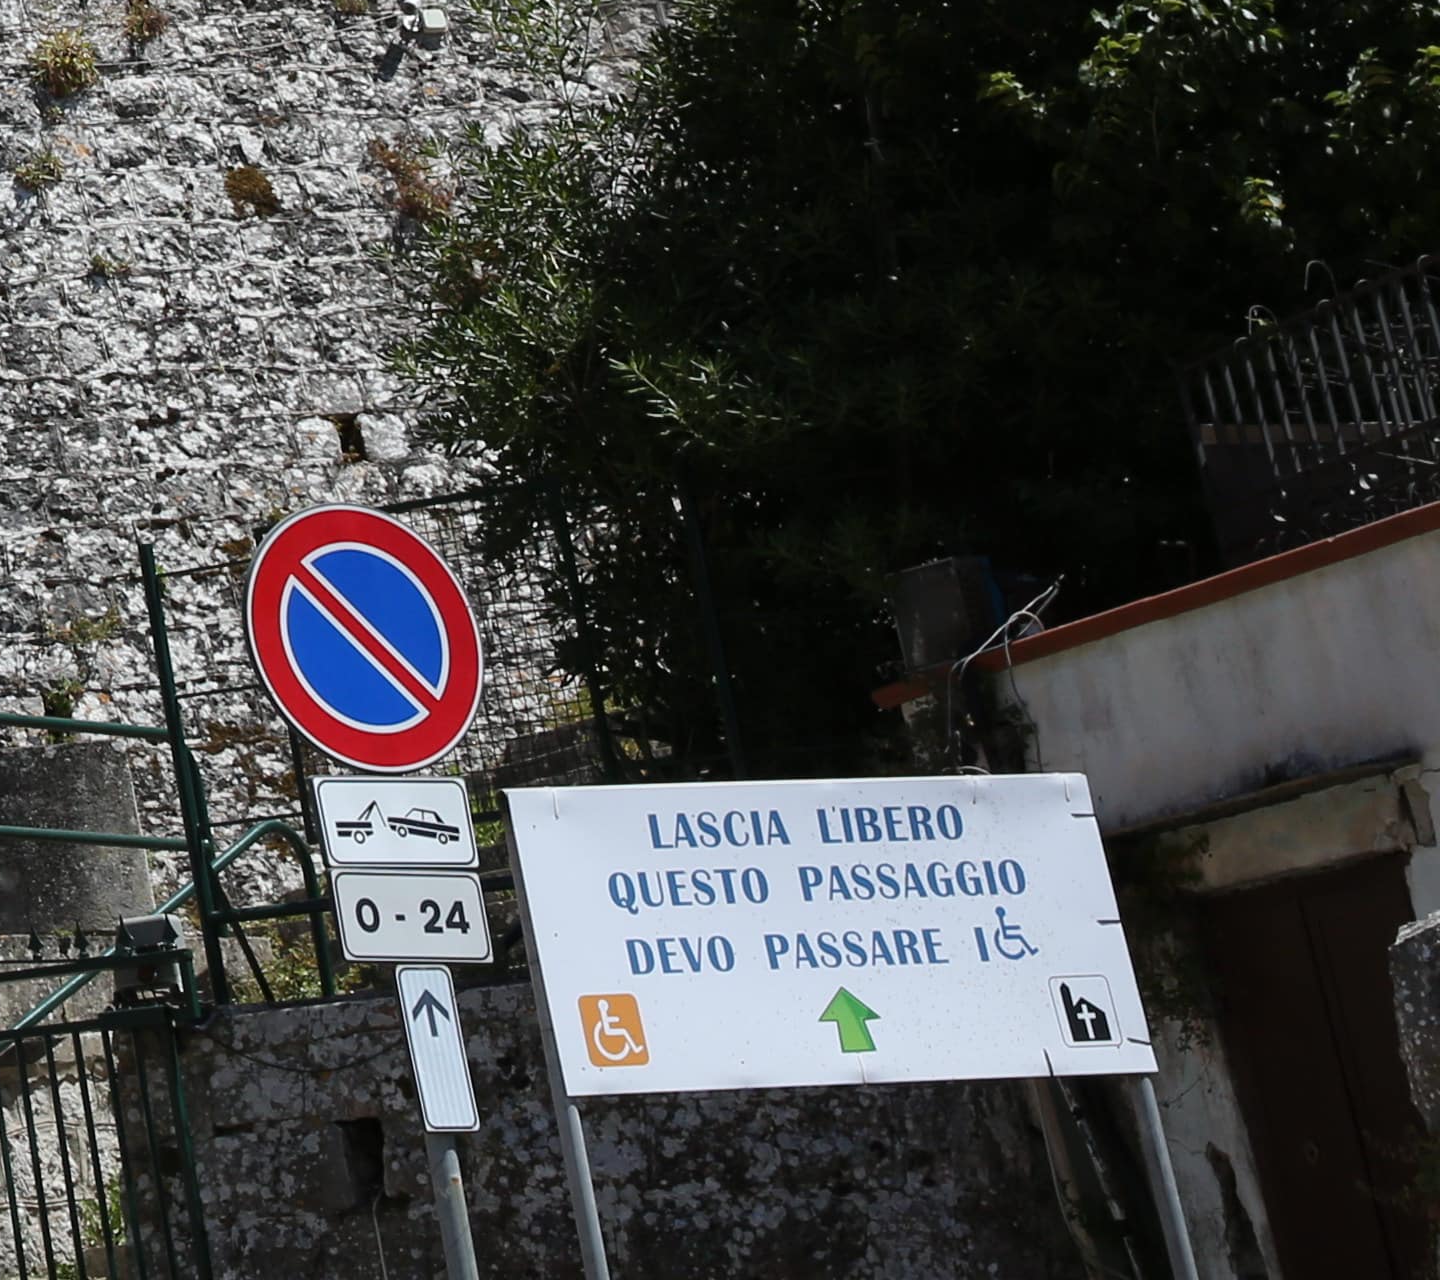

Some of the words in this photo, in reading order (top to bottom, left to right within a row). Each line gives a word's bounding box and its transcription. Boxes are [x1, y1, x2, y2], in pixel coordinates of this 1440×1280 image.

[648, 810, 792, 850] LASCIA
[816, 804, 966, 845] LIBERO
[607, 867, 771, 916] QUESTO
[799, 858, 1028, 904] PASSAGGIO
[355, 897, 381, 933] 0
[419, 899, 472, 934] 24
[625, 932, 737, 977] DEVO
[763, 926, 946, 972] PASSARE
